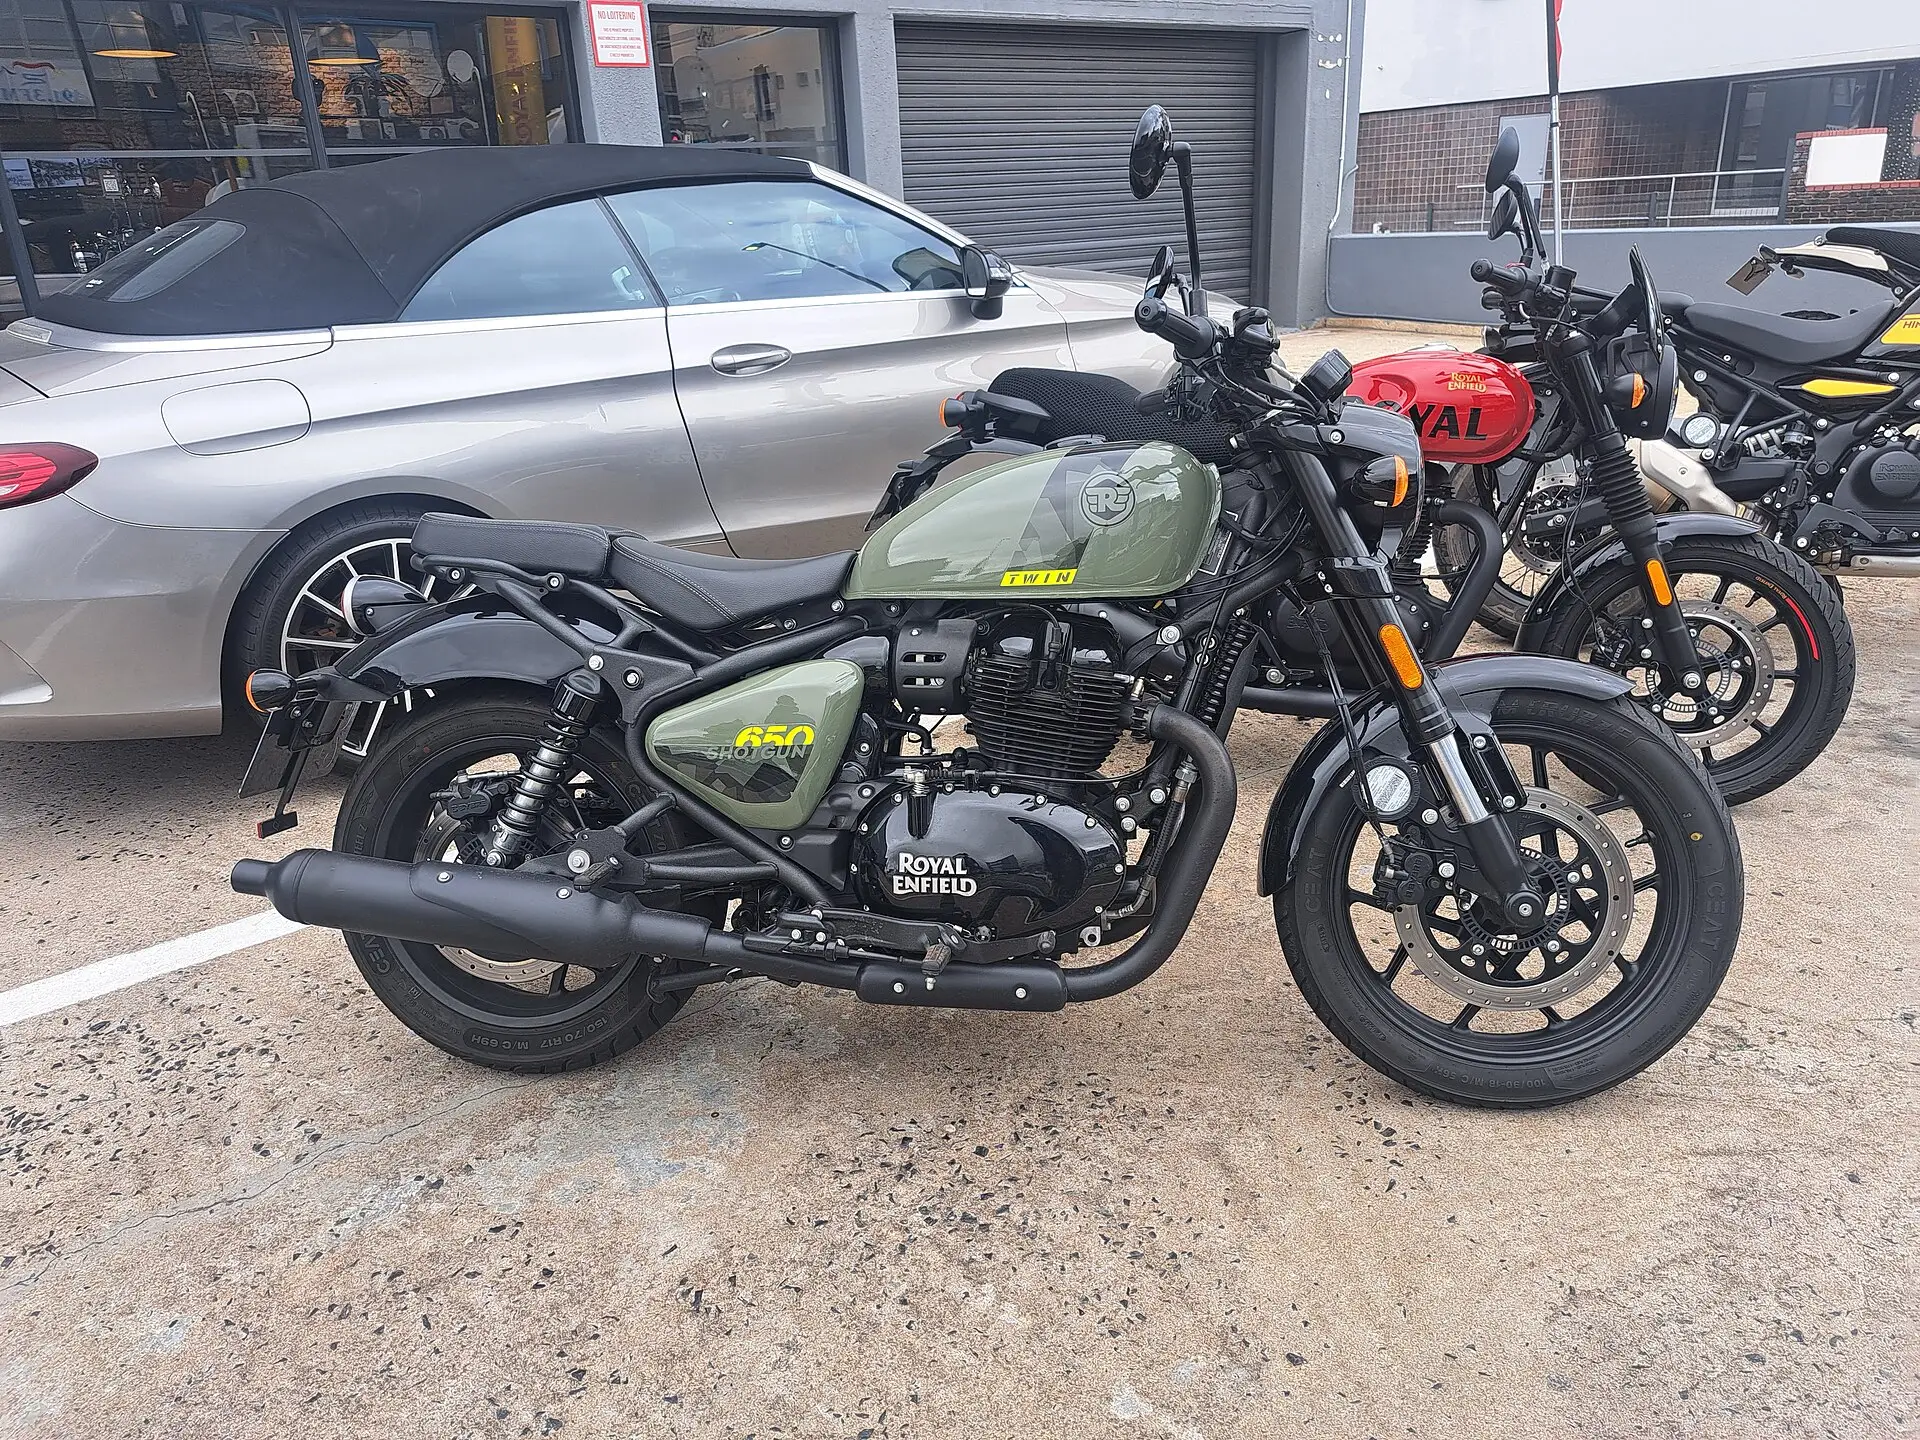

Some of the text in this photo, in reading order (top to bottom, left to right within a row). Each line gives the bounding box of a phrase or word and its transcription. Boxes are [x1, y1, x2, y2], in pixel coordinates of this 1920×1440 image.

[598, 10, 636, 20] NO LOITERING
[1448, 381, 1487, 393] ENFIELD
[1451, 372, 1483, 383] ROYAL
[1009, 572, 1070, 584] TWIN
[735, 725, 815, 747] 650
[706, 744, 806, 760] SHOTGUN
[899, 852, 968, 875] ROYAL
[892, 875, 978, 897] ENFIELD
[1302, 847, 1326, 912] CEAT
[1699, 882, 1728, 953] CEAT
[471, 1017, 608, 1050] 150/70 R17 M/C 69H
